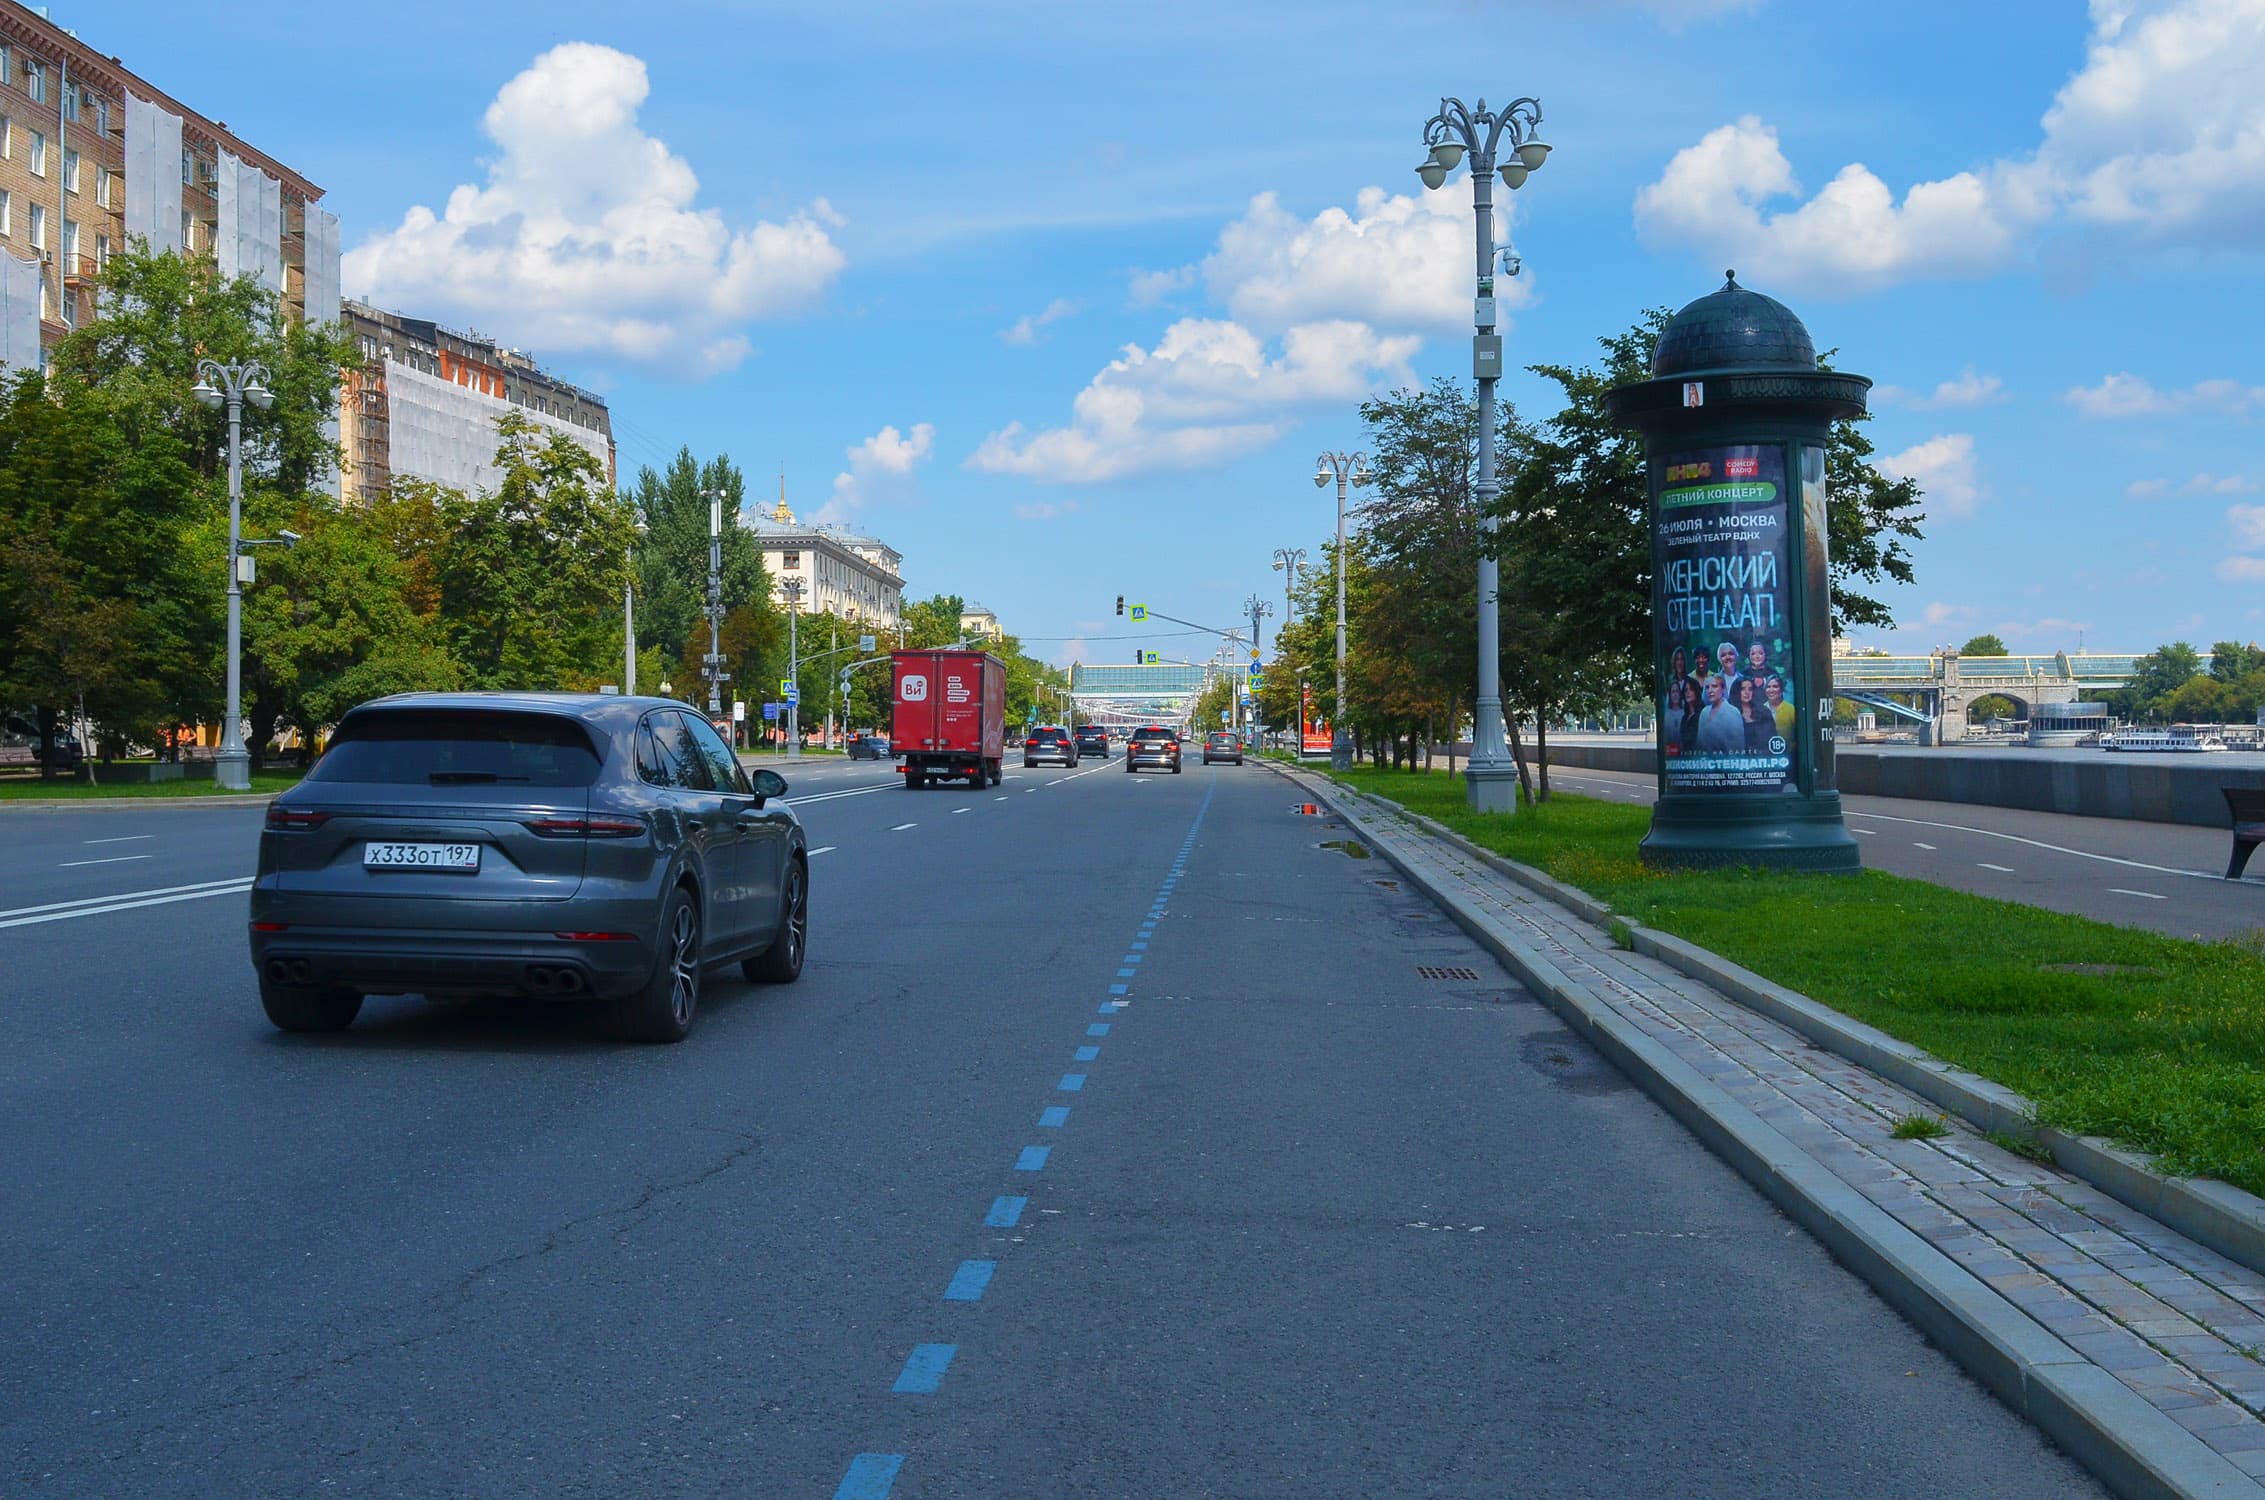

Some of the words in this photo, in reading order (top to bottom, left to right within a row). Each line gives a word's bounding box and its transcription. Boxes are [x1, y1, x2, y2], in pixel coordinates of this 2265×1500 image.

[1726, 458, 1756, 468] COMEDY
[1730, 466, 1753, 474] RADIO
[1666, 488, 1705, 505] ЛЕТНИЙ
[1707, 487, 1764, 499] КОНЦЕРТ
[1658, 523, 1669, 535] 26
[1670, 518, 1703, 533] ИЮЛЯ
[1719, 515, 1777, 528] МОСКВА
[1703, 532, 1732, 543] ТЕАТР
[1733, 531, 1761, 542] ВДНХ
[1662, 551, 1777, 594] ЖЕНСКИЙ
[1667, 593, 1775, 633] СТЕНДАП
[1771, 740, 1785, 750] 18+
[446, 846, 473, 860] 197
